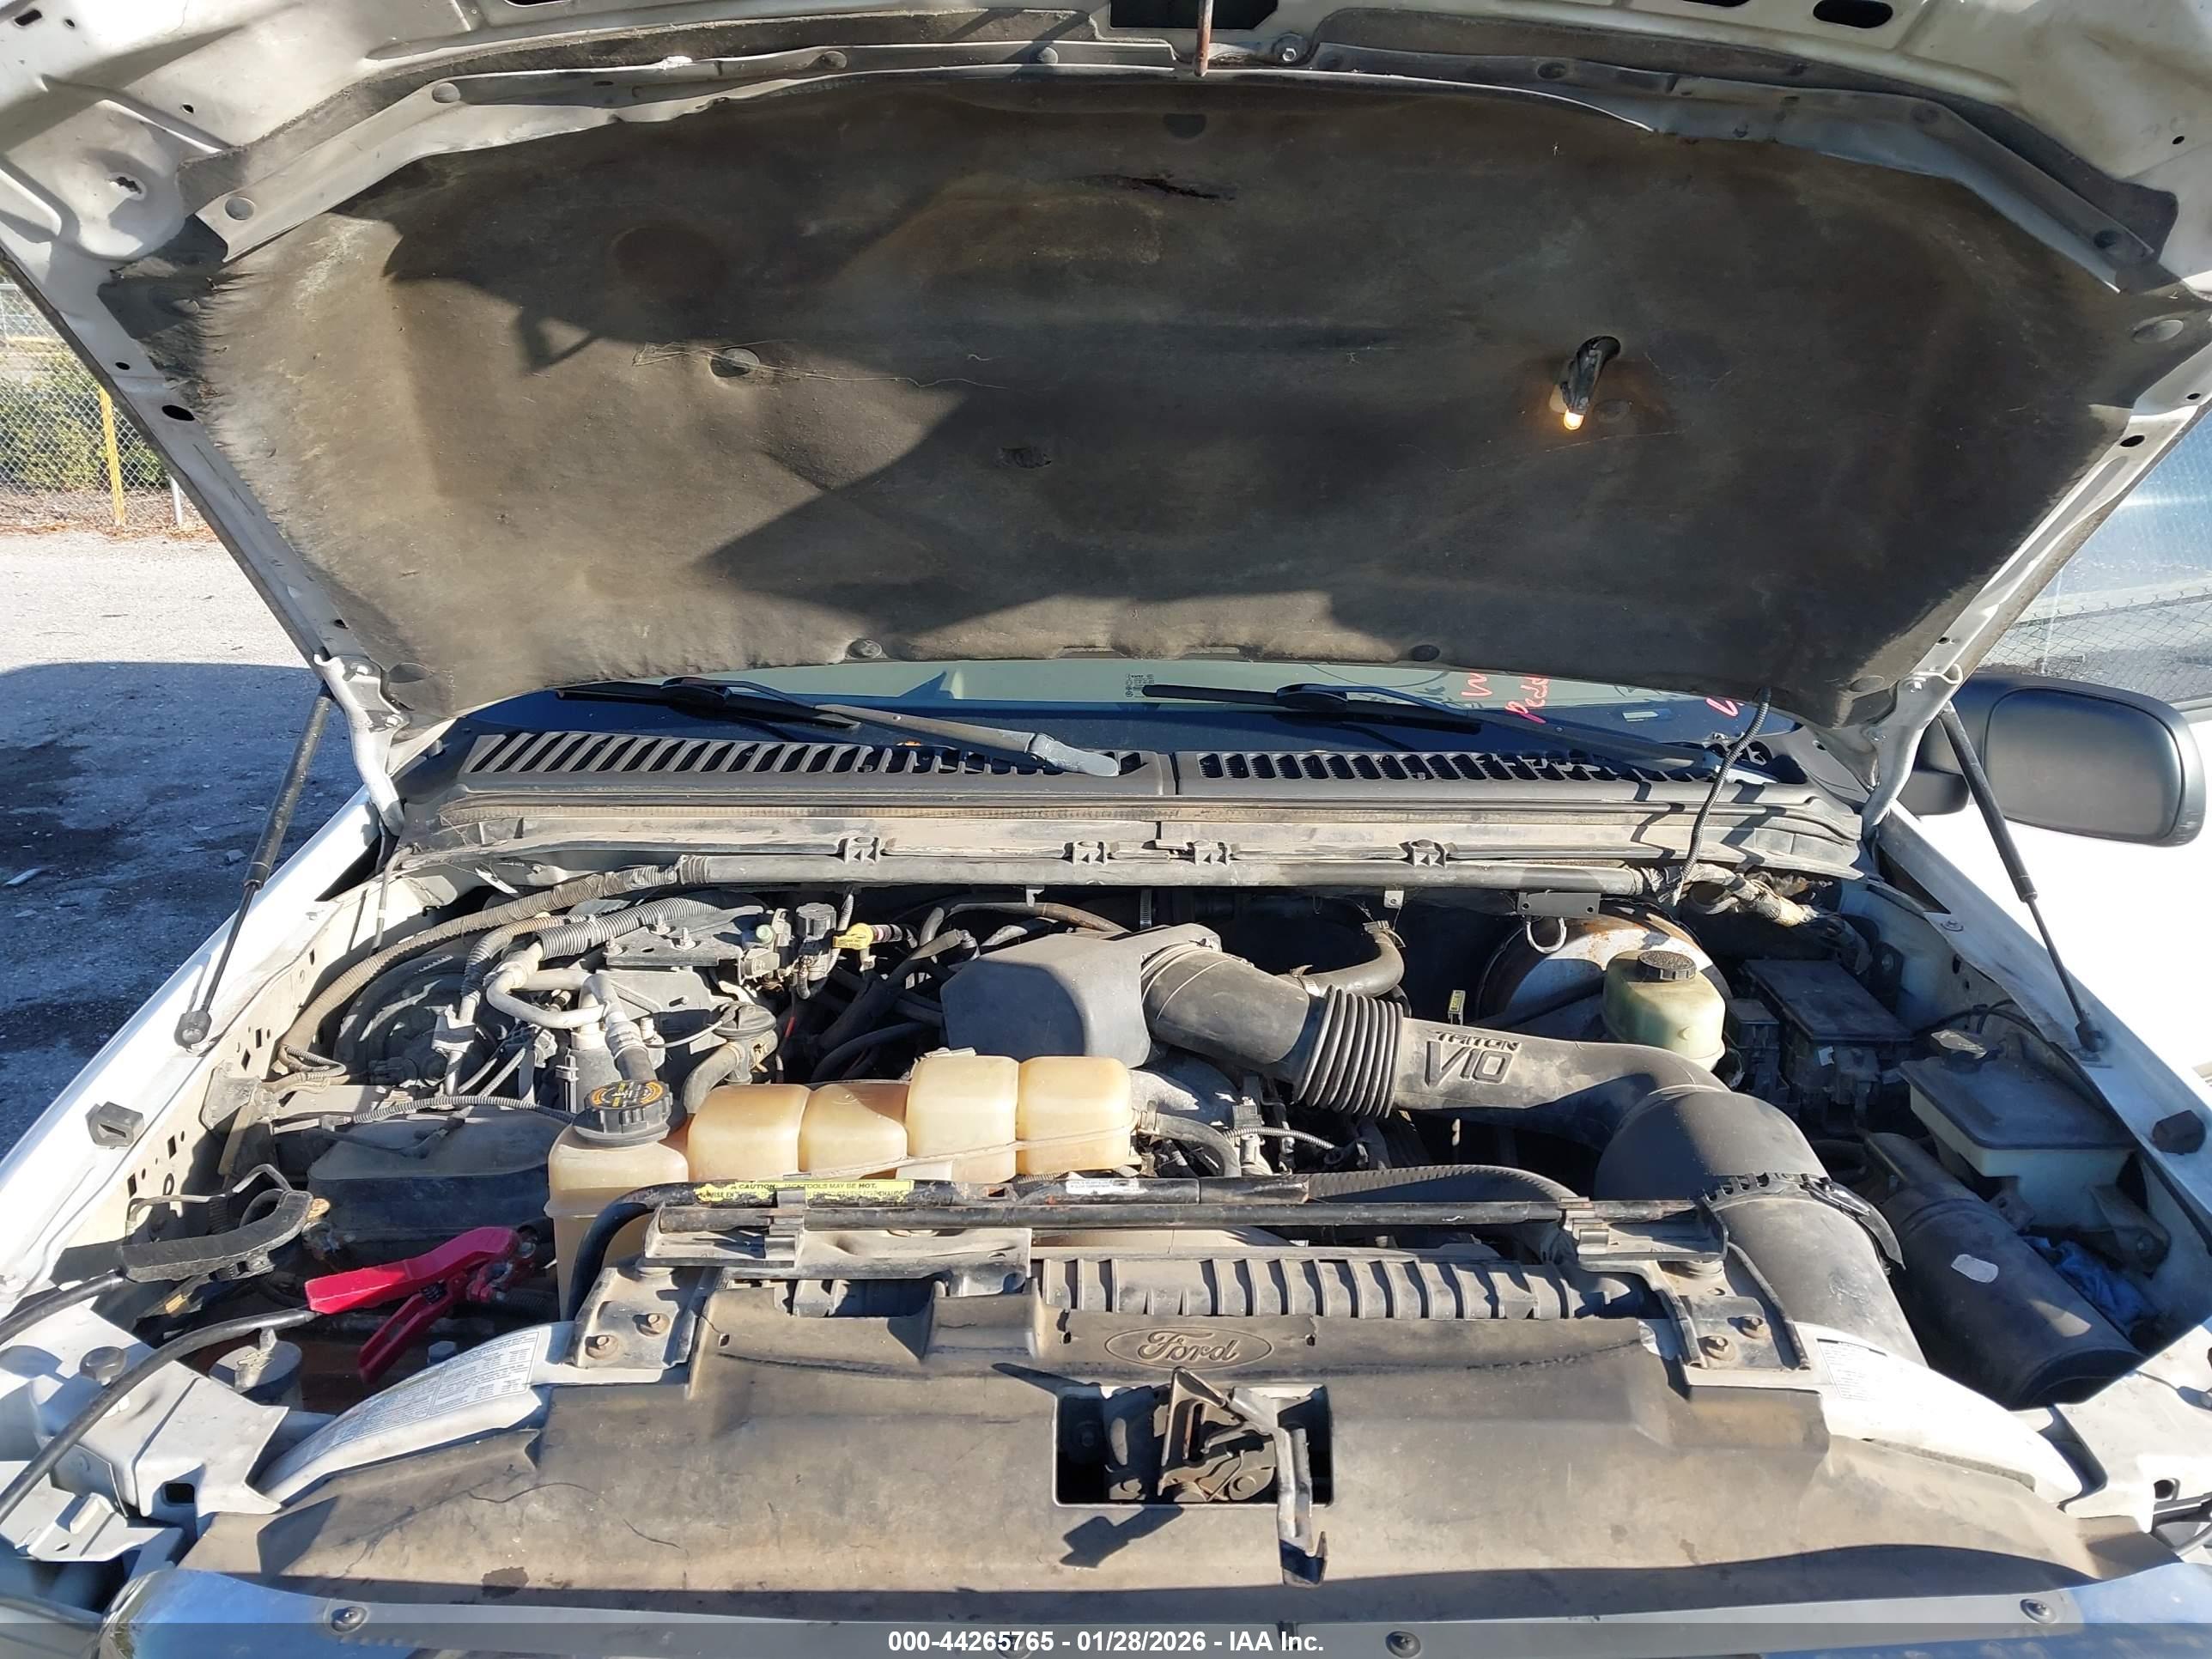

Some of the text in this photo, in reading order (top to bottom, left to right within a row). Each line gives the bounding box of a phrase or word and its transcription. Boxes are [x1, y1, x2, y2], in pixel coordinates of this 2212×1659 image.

[1435, 1030, 1521, 1051] TRITON
[1424, 1040, 1514, 1088] V10
[1137, 1331, 1239, 1361] Ford
